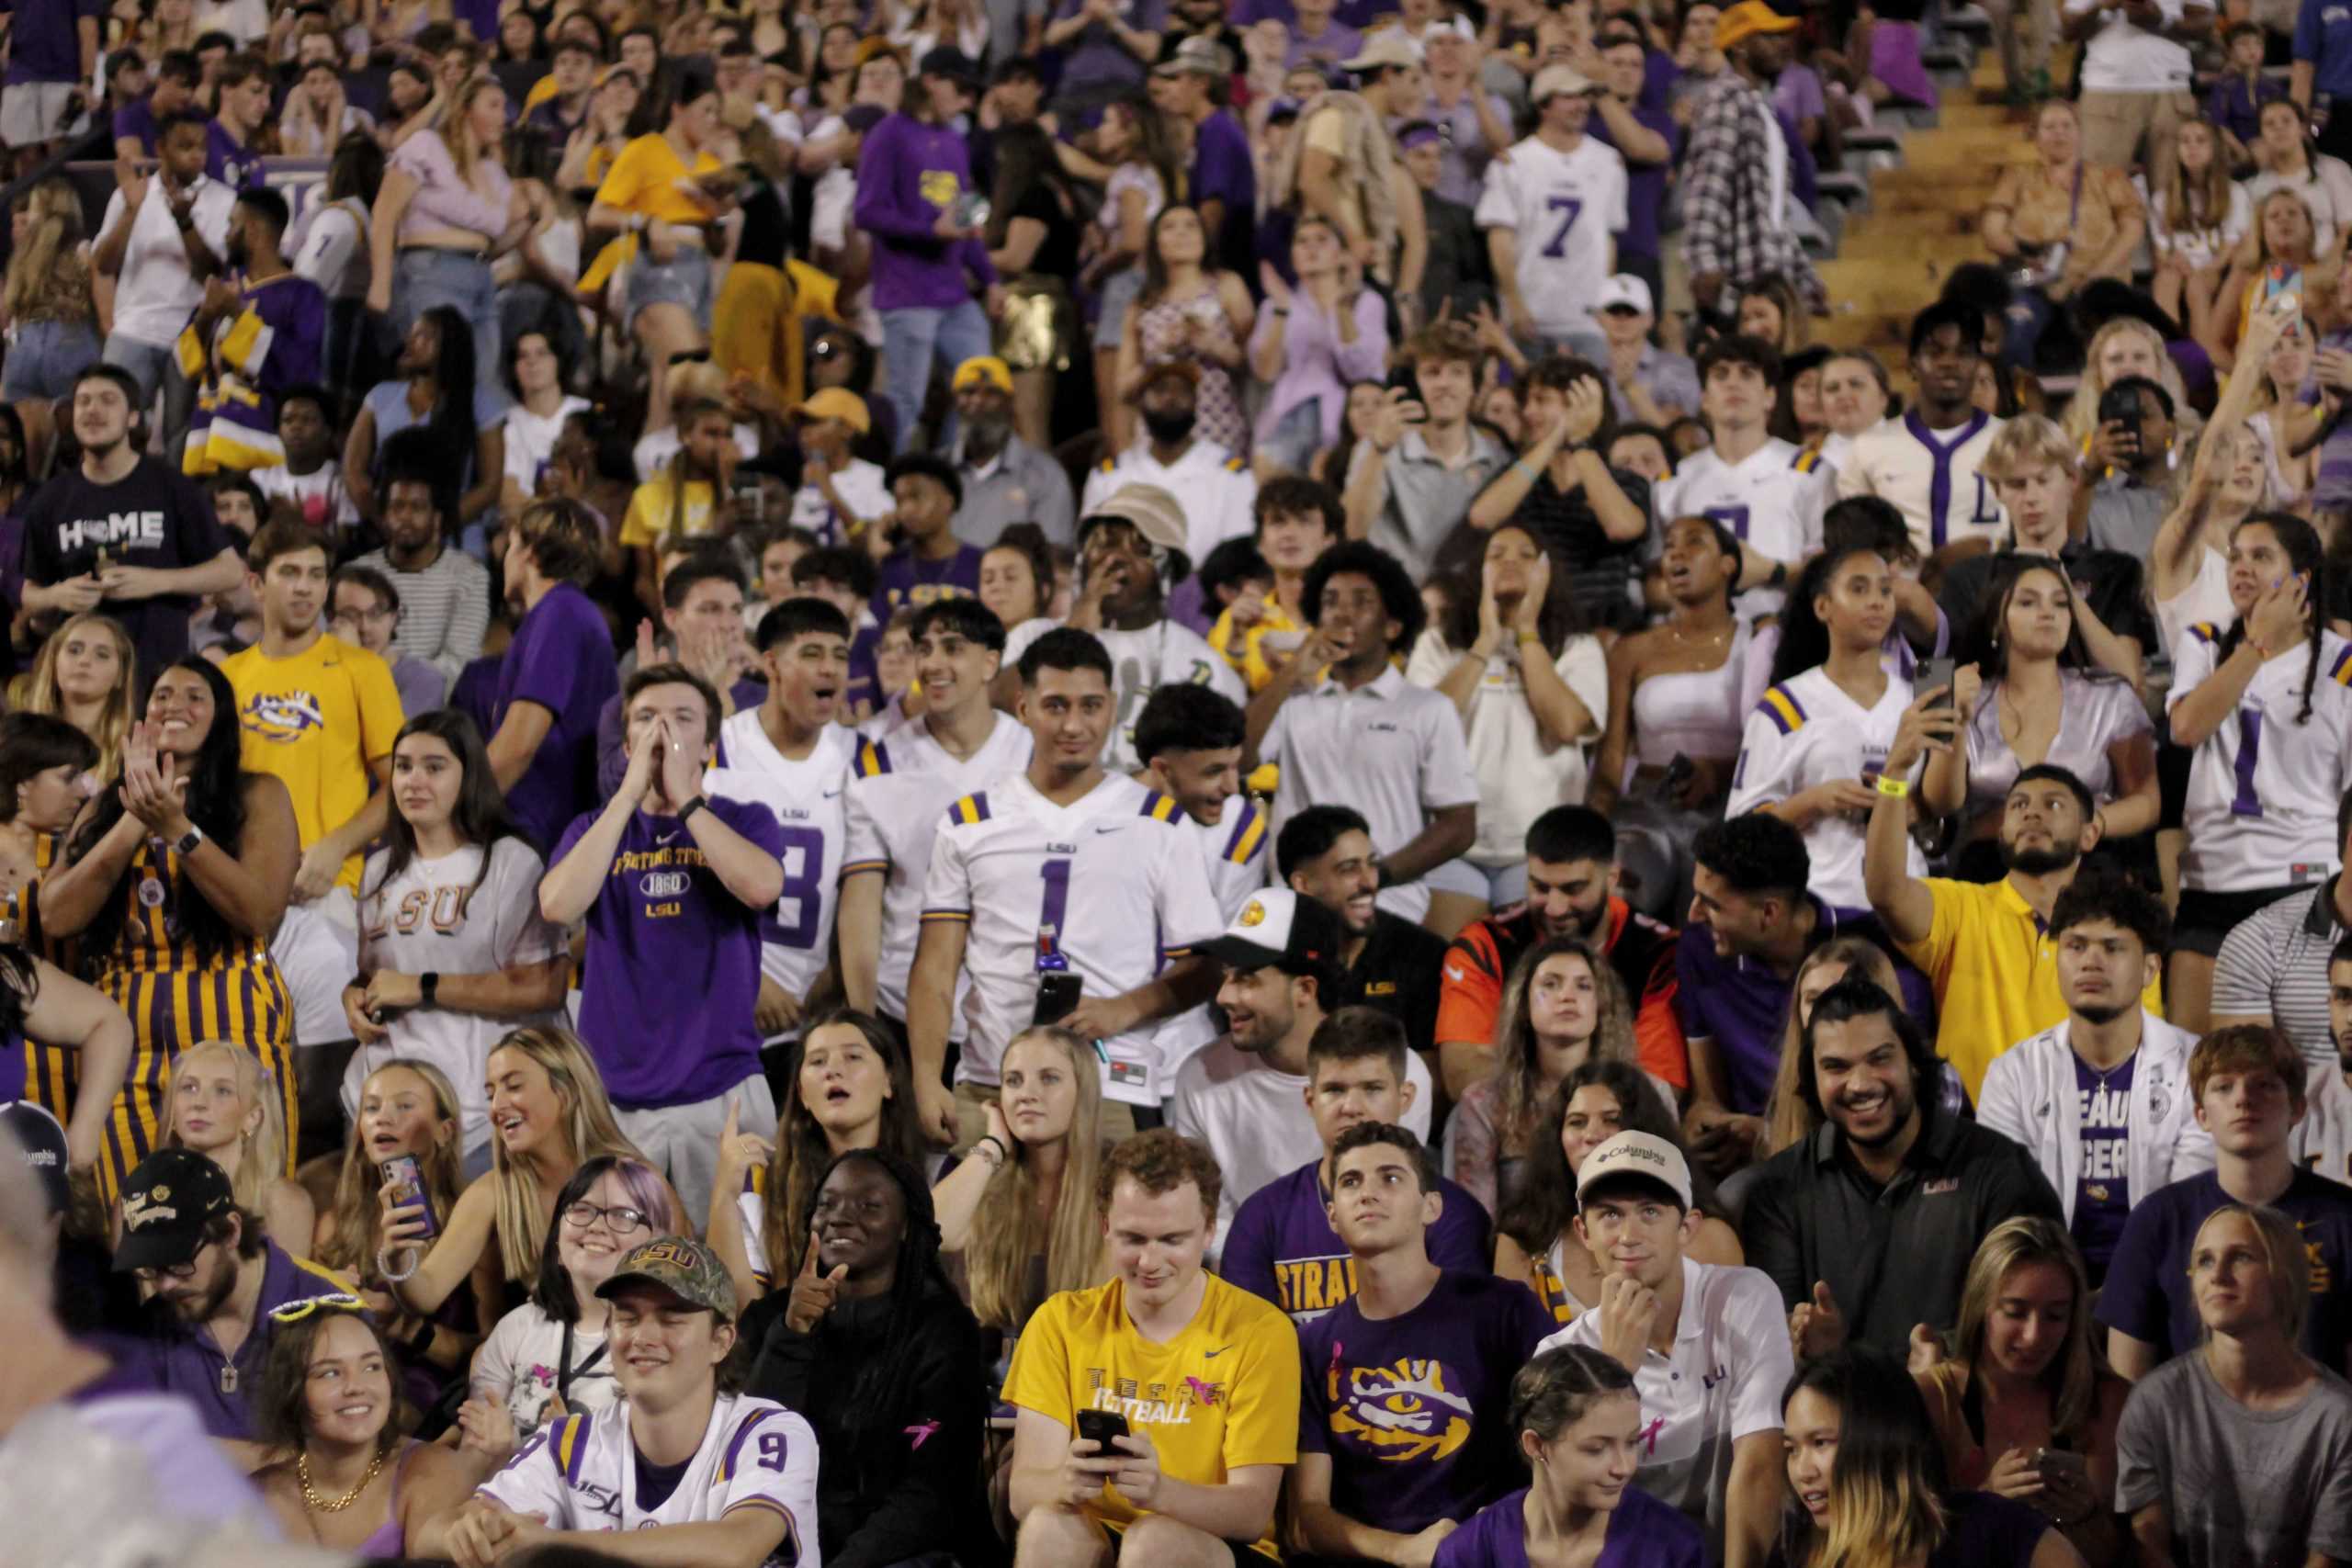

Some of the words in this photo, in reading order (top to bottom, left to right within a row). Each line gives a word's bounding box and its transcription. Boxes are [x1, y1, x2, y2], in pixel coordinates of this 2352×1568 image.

[1543, 195, 1583, 258] 7
[2231, 707, 2264, 818] 1
[783, 808, 809, 819] LSU
[1046, 842, 1078, 854] LSU
[649, 874, 682, 894] 1860
[367, 883, 471, 942] LSU
[645, 902, 682, 918] LSU
[1040, 859, 1071, 946] 1
[1365, 981, 1397, 995] LSU
[1609, 1145, 1667, 1164] Columbia
[632, 1243, 696, 1269] LSU
[758, 1432, 787, 1473] 9
